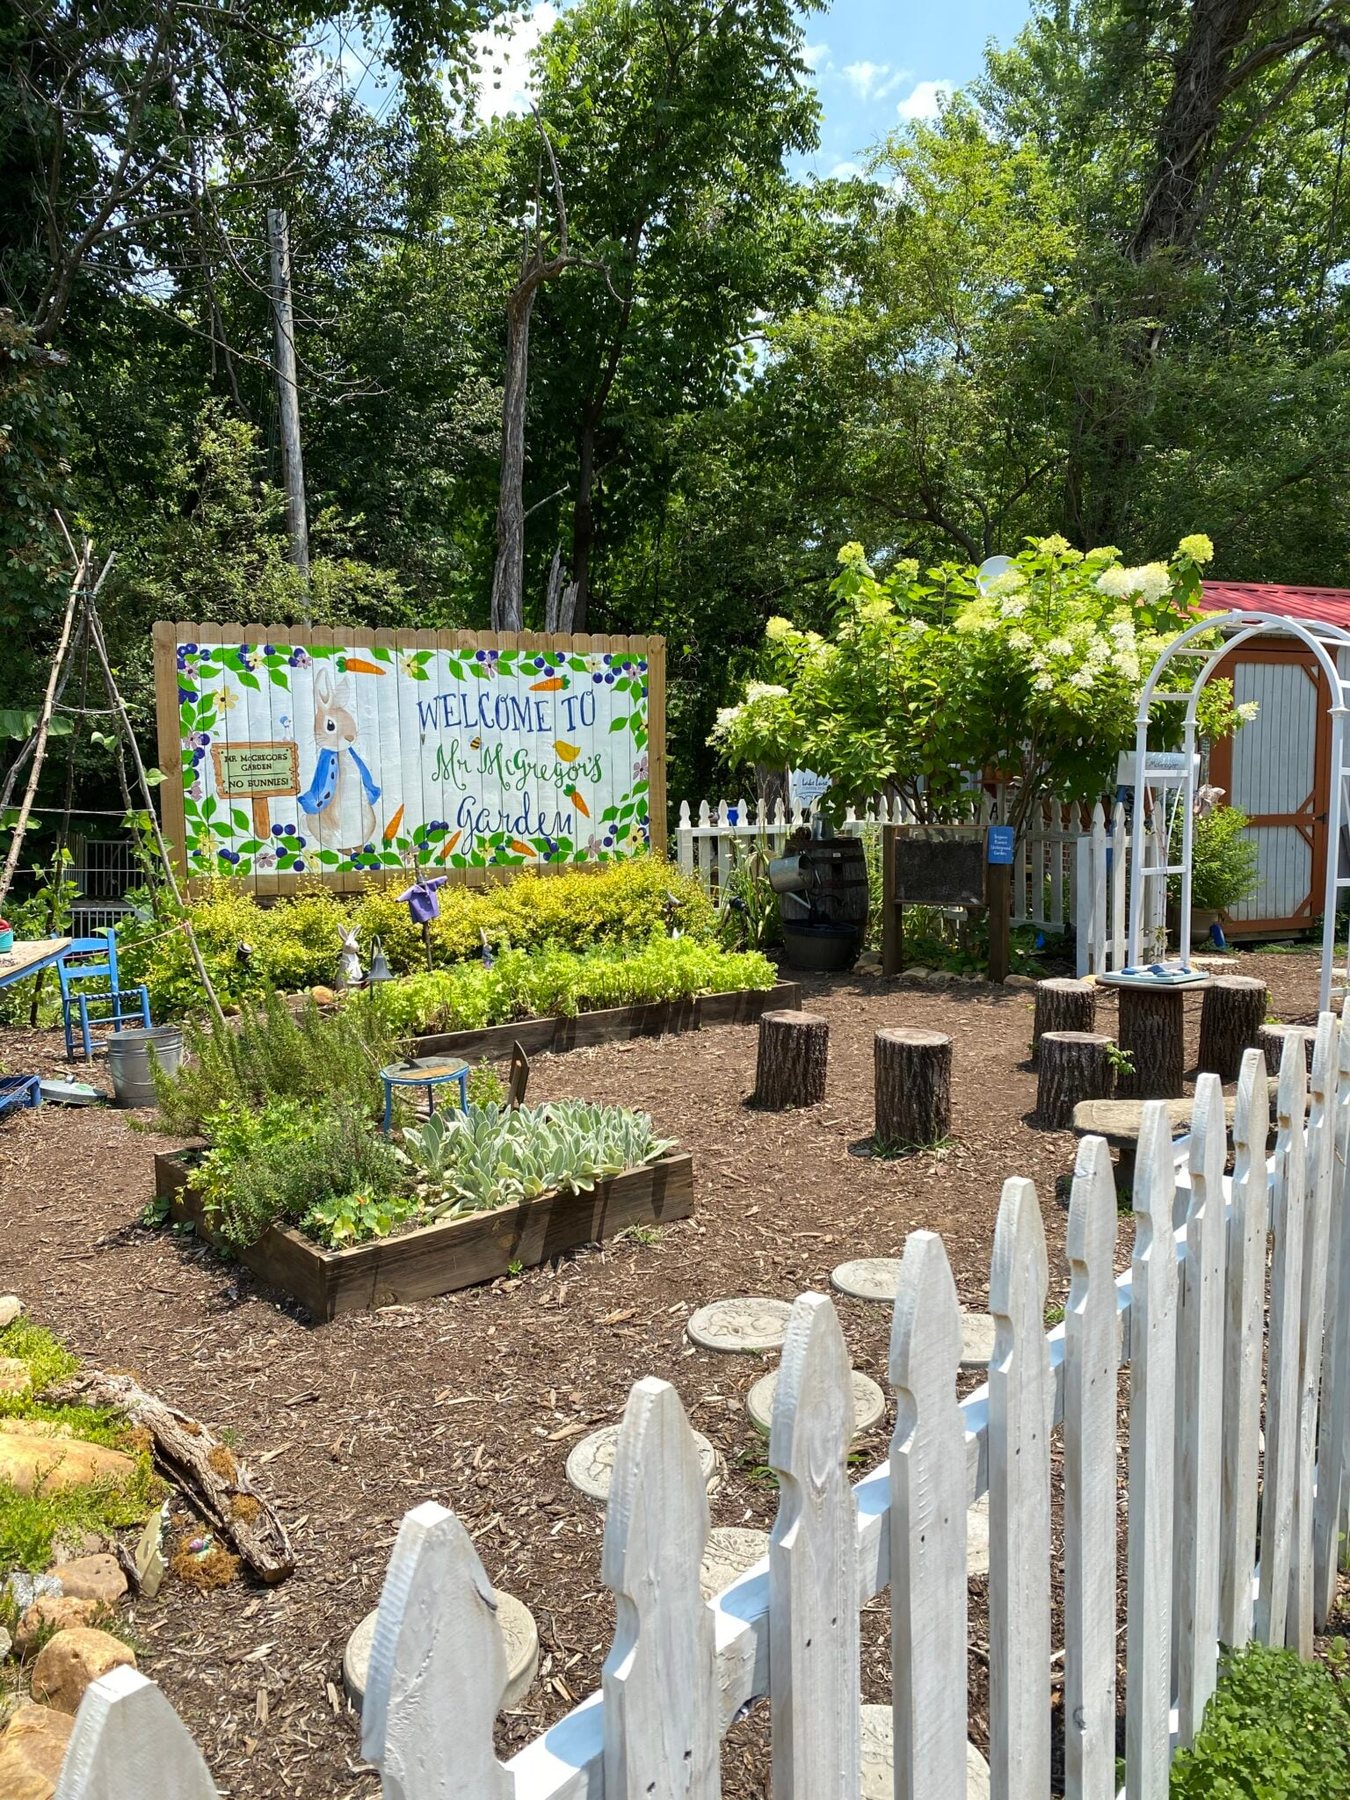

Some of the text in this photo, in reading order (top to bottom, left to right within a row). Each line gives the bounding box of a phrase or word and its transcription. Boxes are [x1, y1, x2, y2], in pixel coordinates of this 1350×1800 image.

[416, 689, 596, 732] WELCOME TO
[229, 780, 244, 788] NO
[477, 742, 602, 791] McGregor's
[456, 791, 573, 856] Garden
